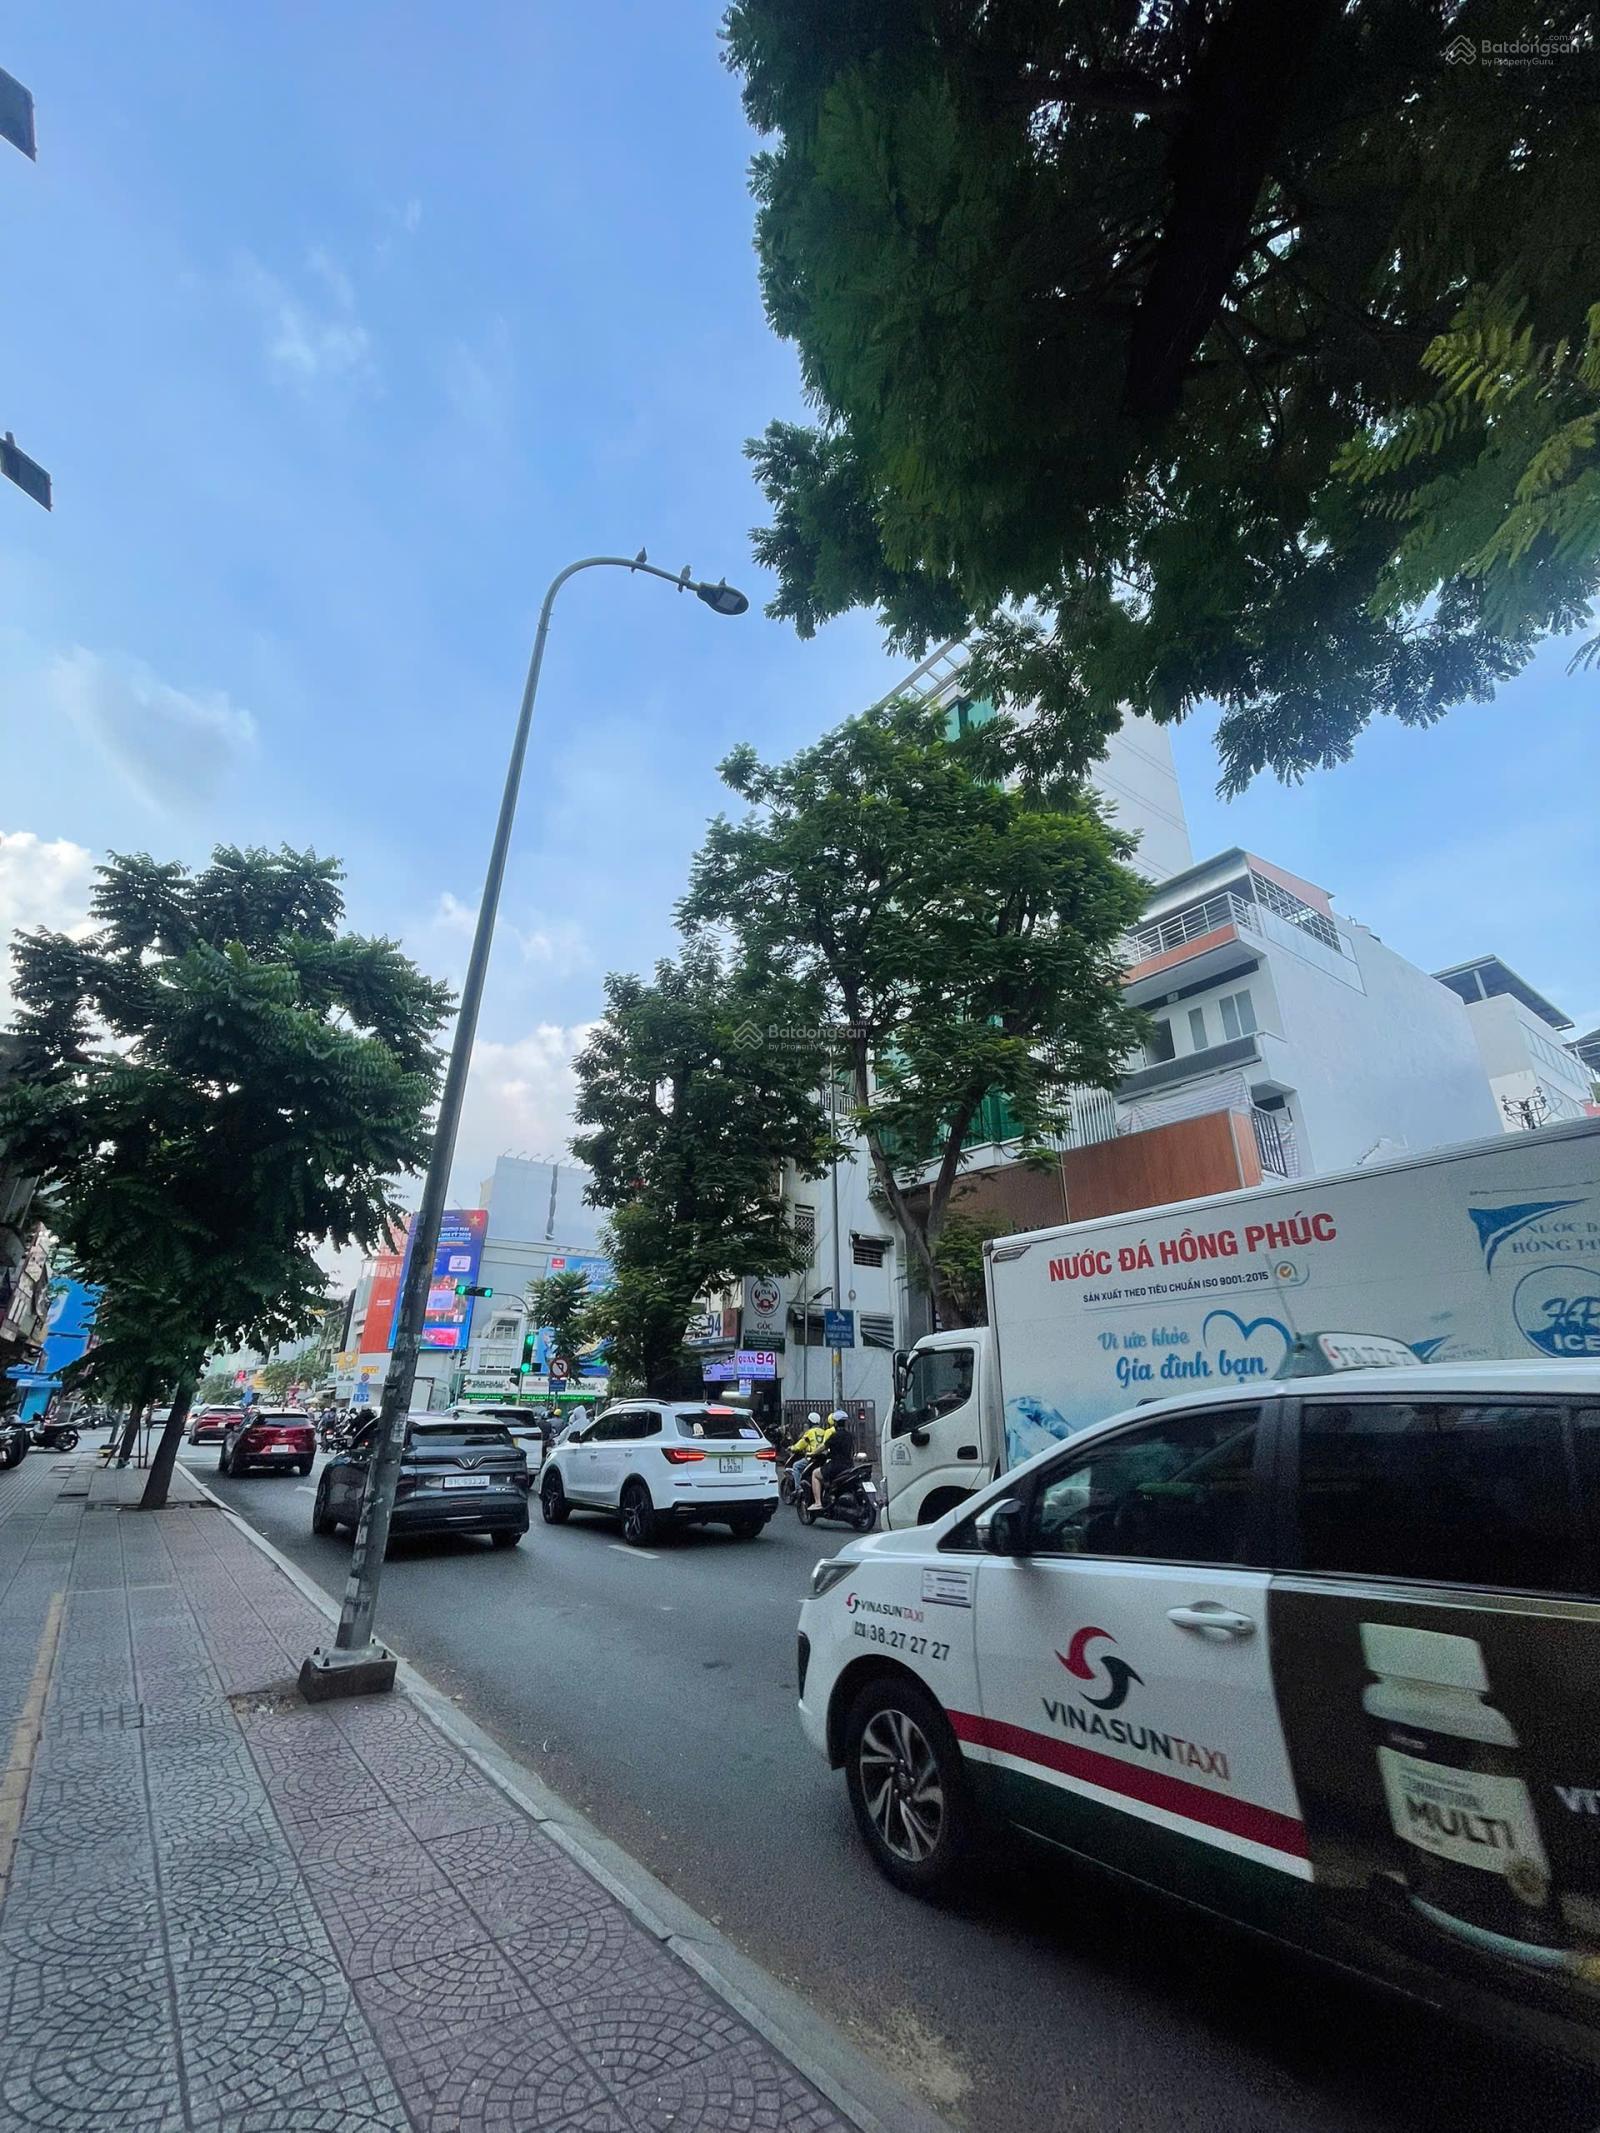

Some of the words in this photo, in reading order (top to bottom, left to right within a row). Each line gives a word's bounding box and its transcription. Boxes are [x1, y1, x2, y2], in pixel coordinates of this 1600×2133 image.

[1049, 1248, 1112, 1282] NƯỚC
[1118, 1239, 1154, 1272] ĐÁ
[1159, 1228, 1238, 1265] HỒNG
[1245, 1211, 1337, 1252] PHÚC
[1083, 1291, 1100, 1302] SẢN
[1101, 1288, 1122, 1301] XUẤT
[1124, 1287, 1146, 1298] THEO
[1147, 1283, 1168, 1295] TIÊU
[1169, 1277, 1201, 1292] CHUẨN
[1202, 1278, 1218, 1288] ISO
[1219, 1271, 1269, 1286] 9001:2015
[756, 1352, 774, 1365] 94
[1115, 1356, 1155, 1389] Gia
[1160, 1351, 1213, 1380] đình
[1218, 1349, 1268, 1384] bạn
[860, 1600, 924, 1623] VINASUNTAXI
[870, 1624, 906, 1649] 38.27
[910, 1636, 928, 1655] 27
[931, 1641, 950, 1661] 27
[1041, 1697, 1232, 1781] VINASUNTAXI
[1405, 1793, 1516, 1850] MULTI
